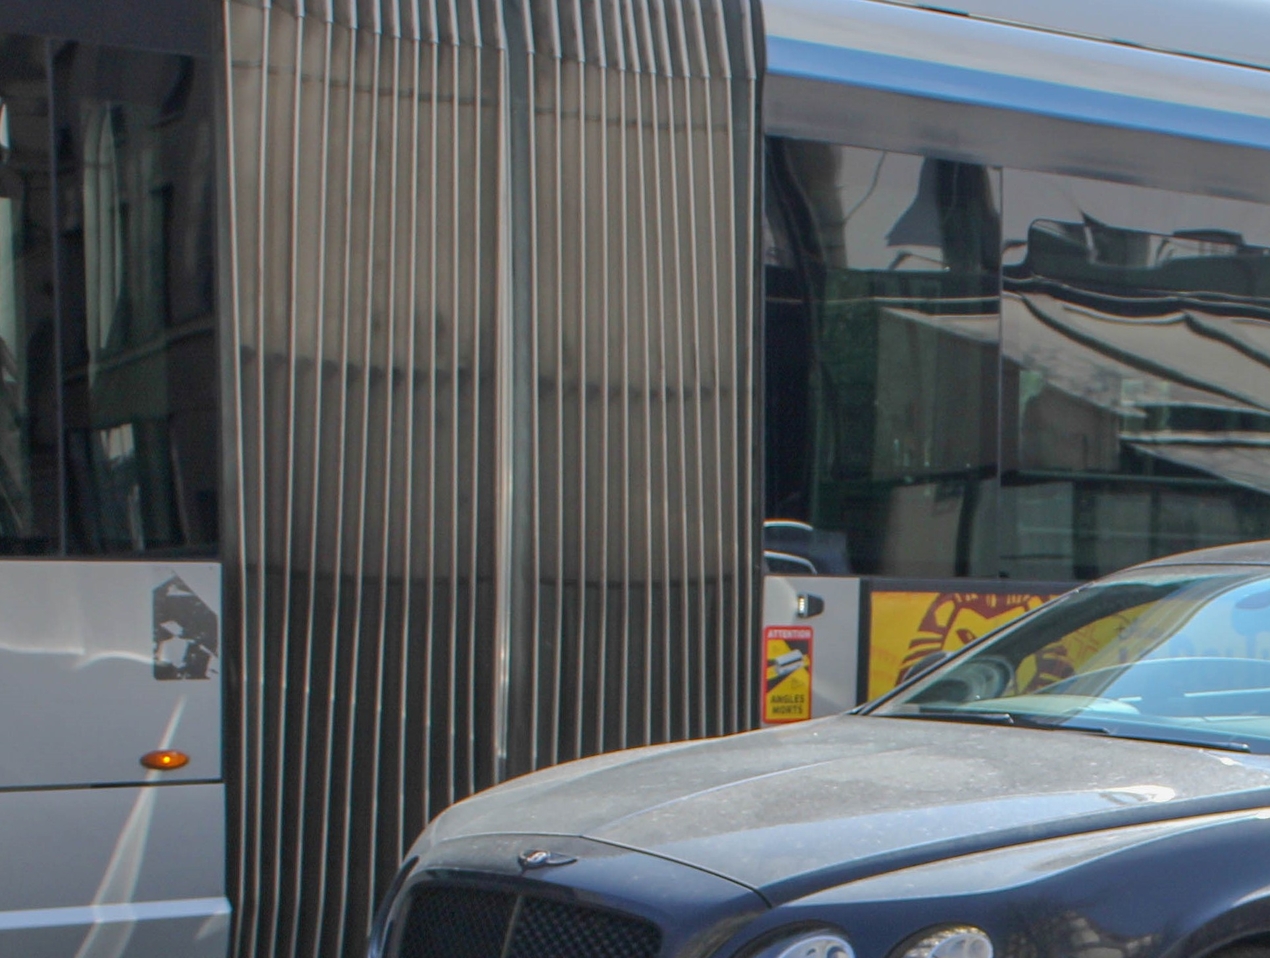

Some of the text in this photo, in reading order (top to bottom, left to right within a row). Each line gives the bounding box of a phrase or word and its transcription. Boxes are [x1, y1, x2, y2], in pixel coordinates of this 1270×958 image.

[767, 629, 811, 639] ATTENTION
[770, 694, 805, 704] ANGLES
[771, 705, 804, 715] MORTS
